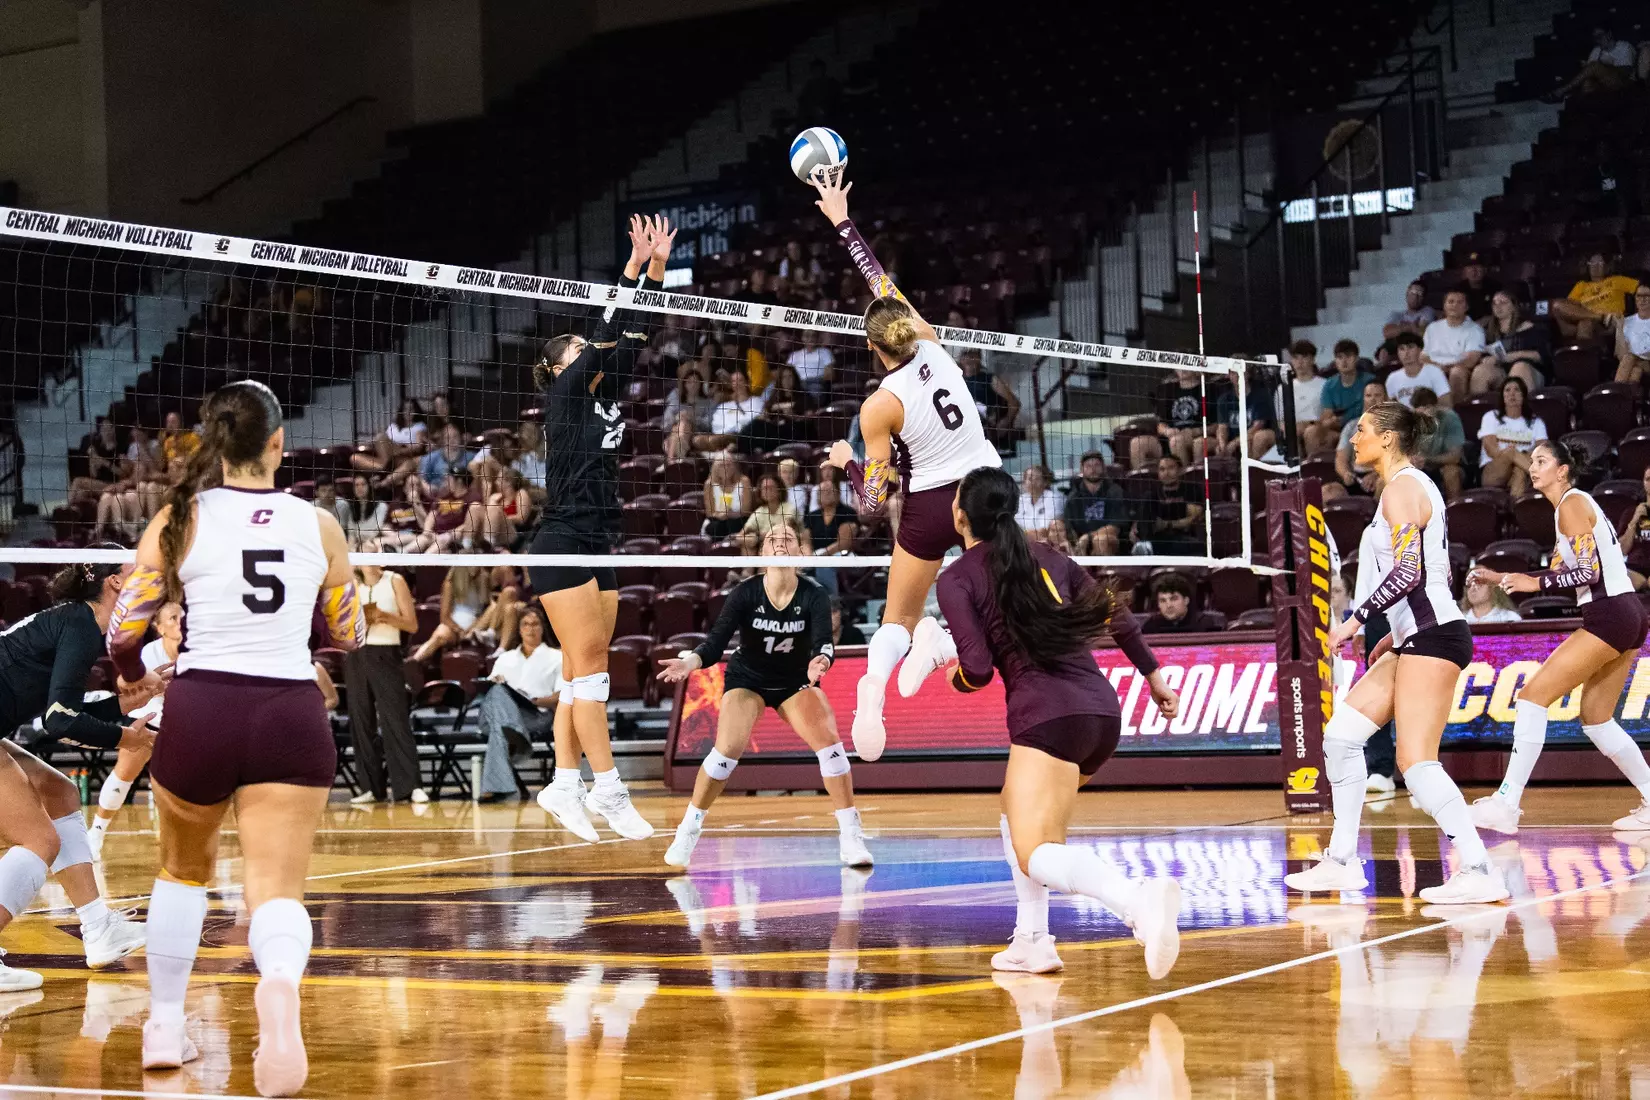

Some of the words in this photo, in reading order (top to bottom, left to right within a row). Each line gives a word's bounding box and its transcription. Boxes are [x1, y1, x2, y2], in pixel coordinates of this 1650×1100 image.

[6, 210, 61, 233] CENTRAL
[62, 217, 125, 242] MICHIGAN
[124, 225, 194, 251] VOLLEYBALL
[250, 242, 297, 264] CENTRAL
[298, 248, 350, 270] MICHIGAN
[350, 255, 409, 277] VOLLEYBALL
[457, 268, 496, 288] CENTRAL
[497, 274, 542, 293] MICHIGAN
[541, 278, 591, 299] VOLLEYBALL
[632, 290, 667, 308] CENTRAL
[667, 295, 705, 312] MICHIGAN
[705, 299, 749, 317] VOLLEYBALL
[784, 308, 814, 325] CENTRAL
[815, 312, 848, 329] MICHIGAN
[944, 328, 974, 343] MICHIGAN
[973, 332, 1007, 346] VOLLEYBALL
[1033, 338, 1056, 352] CENTRAL
[1057, 340, 1083, 355] MICHIGAN
[1083, 344, 1112, 358] VOLLEYBALL
[1136, 350, 1157, 362] CENTRAL
[1158, 352, 1181, 365] MICHIGAN
[932, 388, 964, 431] 6
[242, 549, 285, 613] 5
[1370, 550, 1418, 609] CHIPPEWAS
[752, 617, 806, 634] OAKLAND
[763, 636, 795, 655] 14
[1099, 662, 1278, 735] ELCOME
[1291, 676, 1304, 714] sports
[1294, 714, 1307, 759] imports
